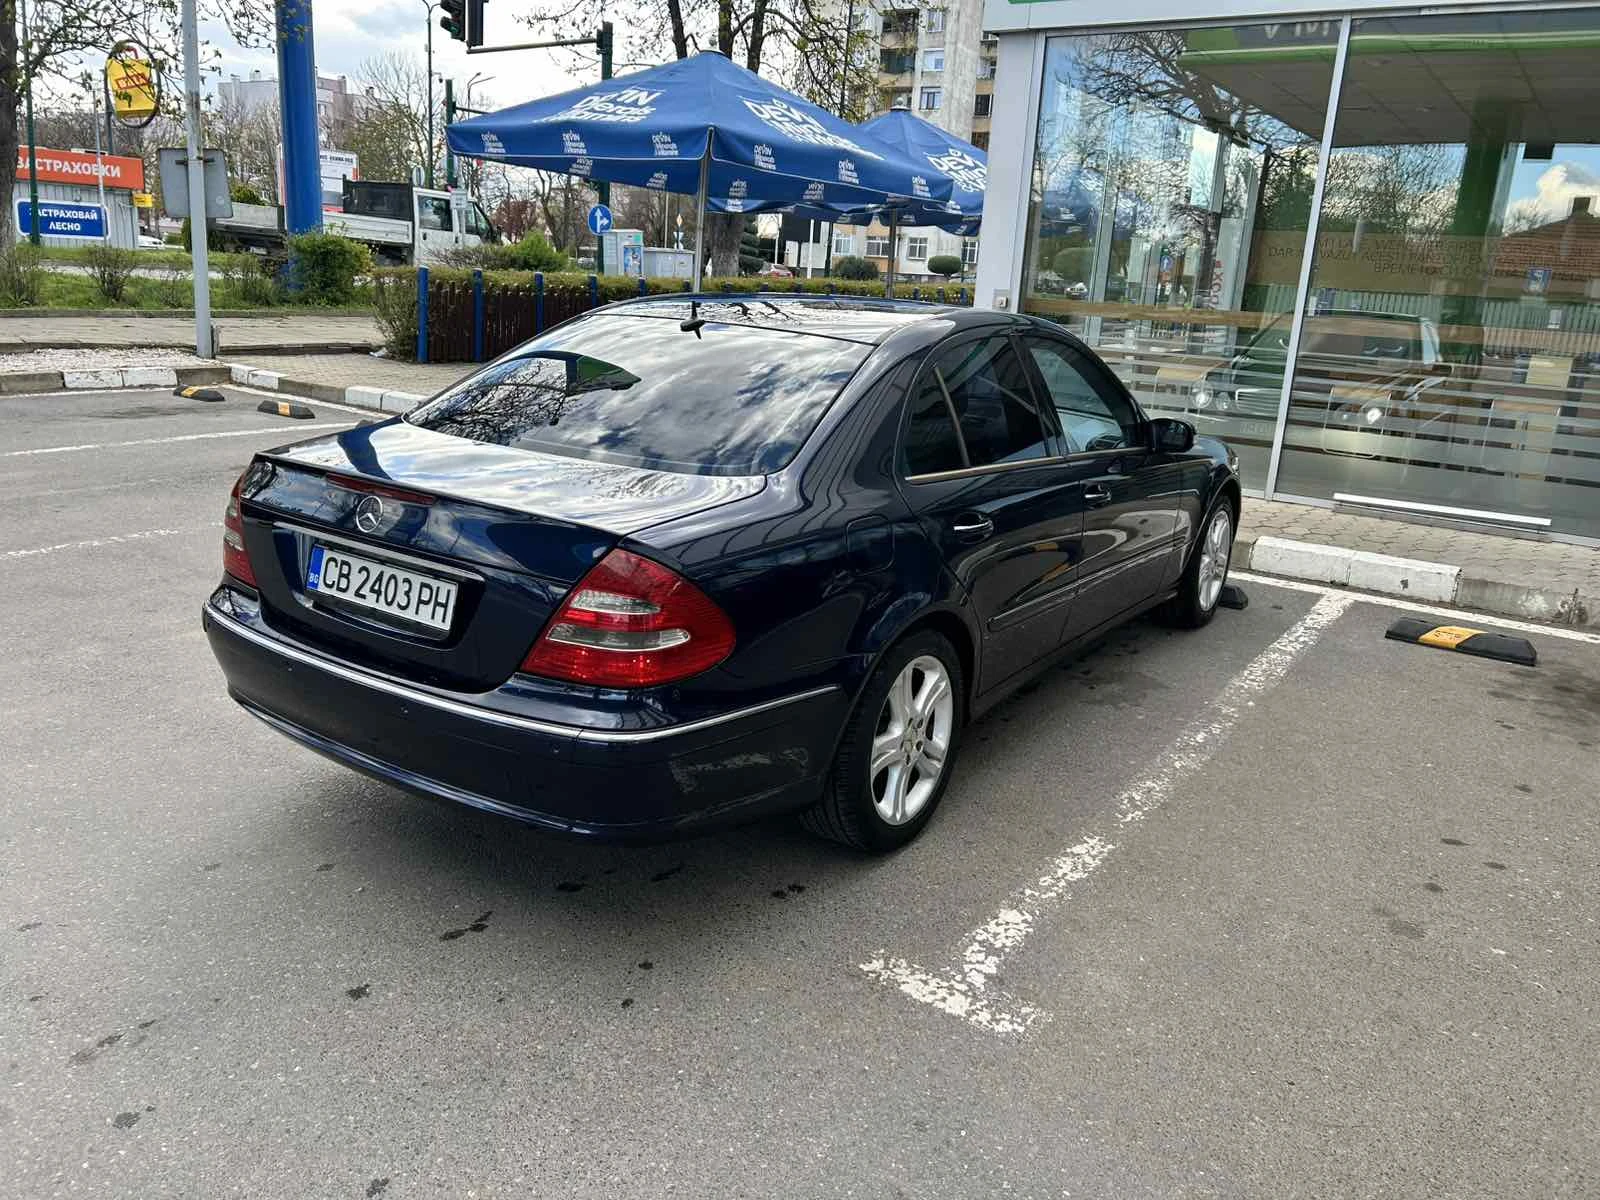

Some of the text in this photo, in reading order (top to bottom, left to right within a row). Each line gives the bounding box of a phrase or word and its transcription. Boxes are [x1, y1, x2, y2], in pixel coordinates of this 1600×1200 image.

[49, 221, 80, 231] ЛЕСНО
[308, 572, 319, 583] BG
[323, 557, 451, 623] CB 2403 PH
